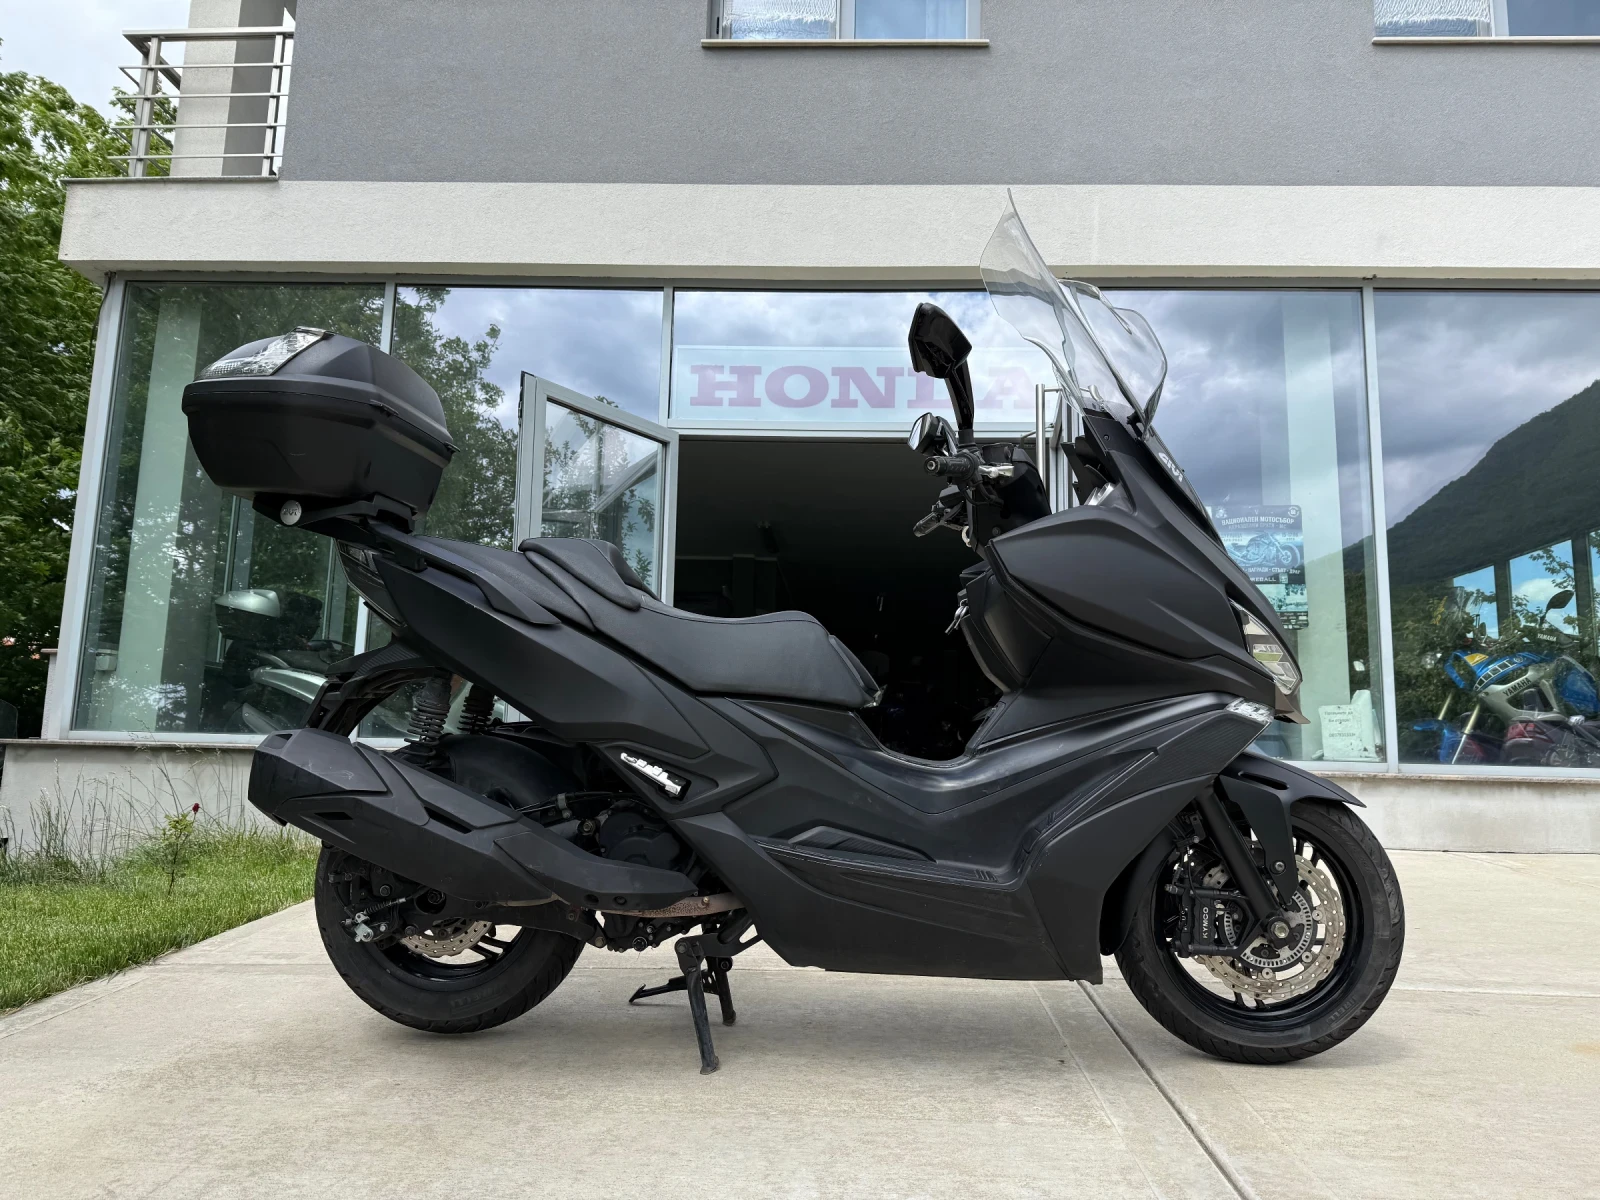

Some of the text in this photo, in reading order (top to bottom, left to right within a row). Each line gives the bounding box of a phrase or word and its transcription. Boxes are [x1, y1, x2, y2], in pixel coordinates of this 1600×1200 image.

[1260, 516, 1294, 524] МОТОСЪБОР
[1537, 633, 1557, 642] YAMAHA
[1503, 677, 1532, 697] YAMAHA
